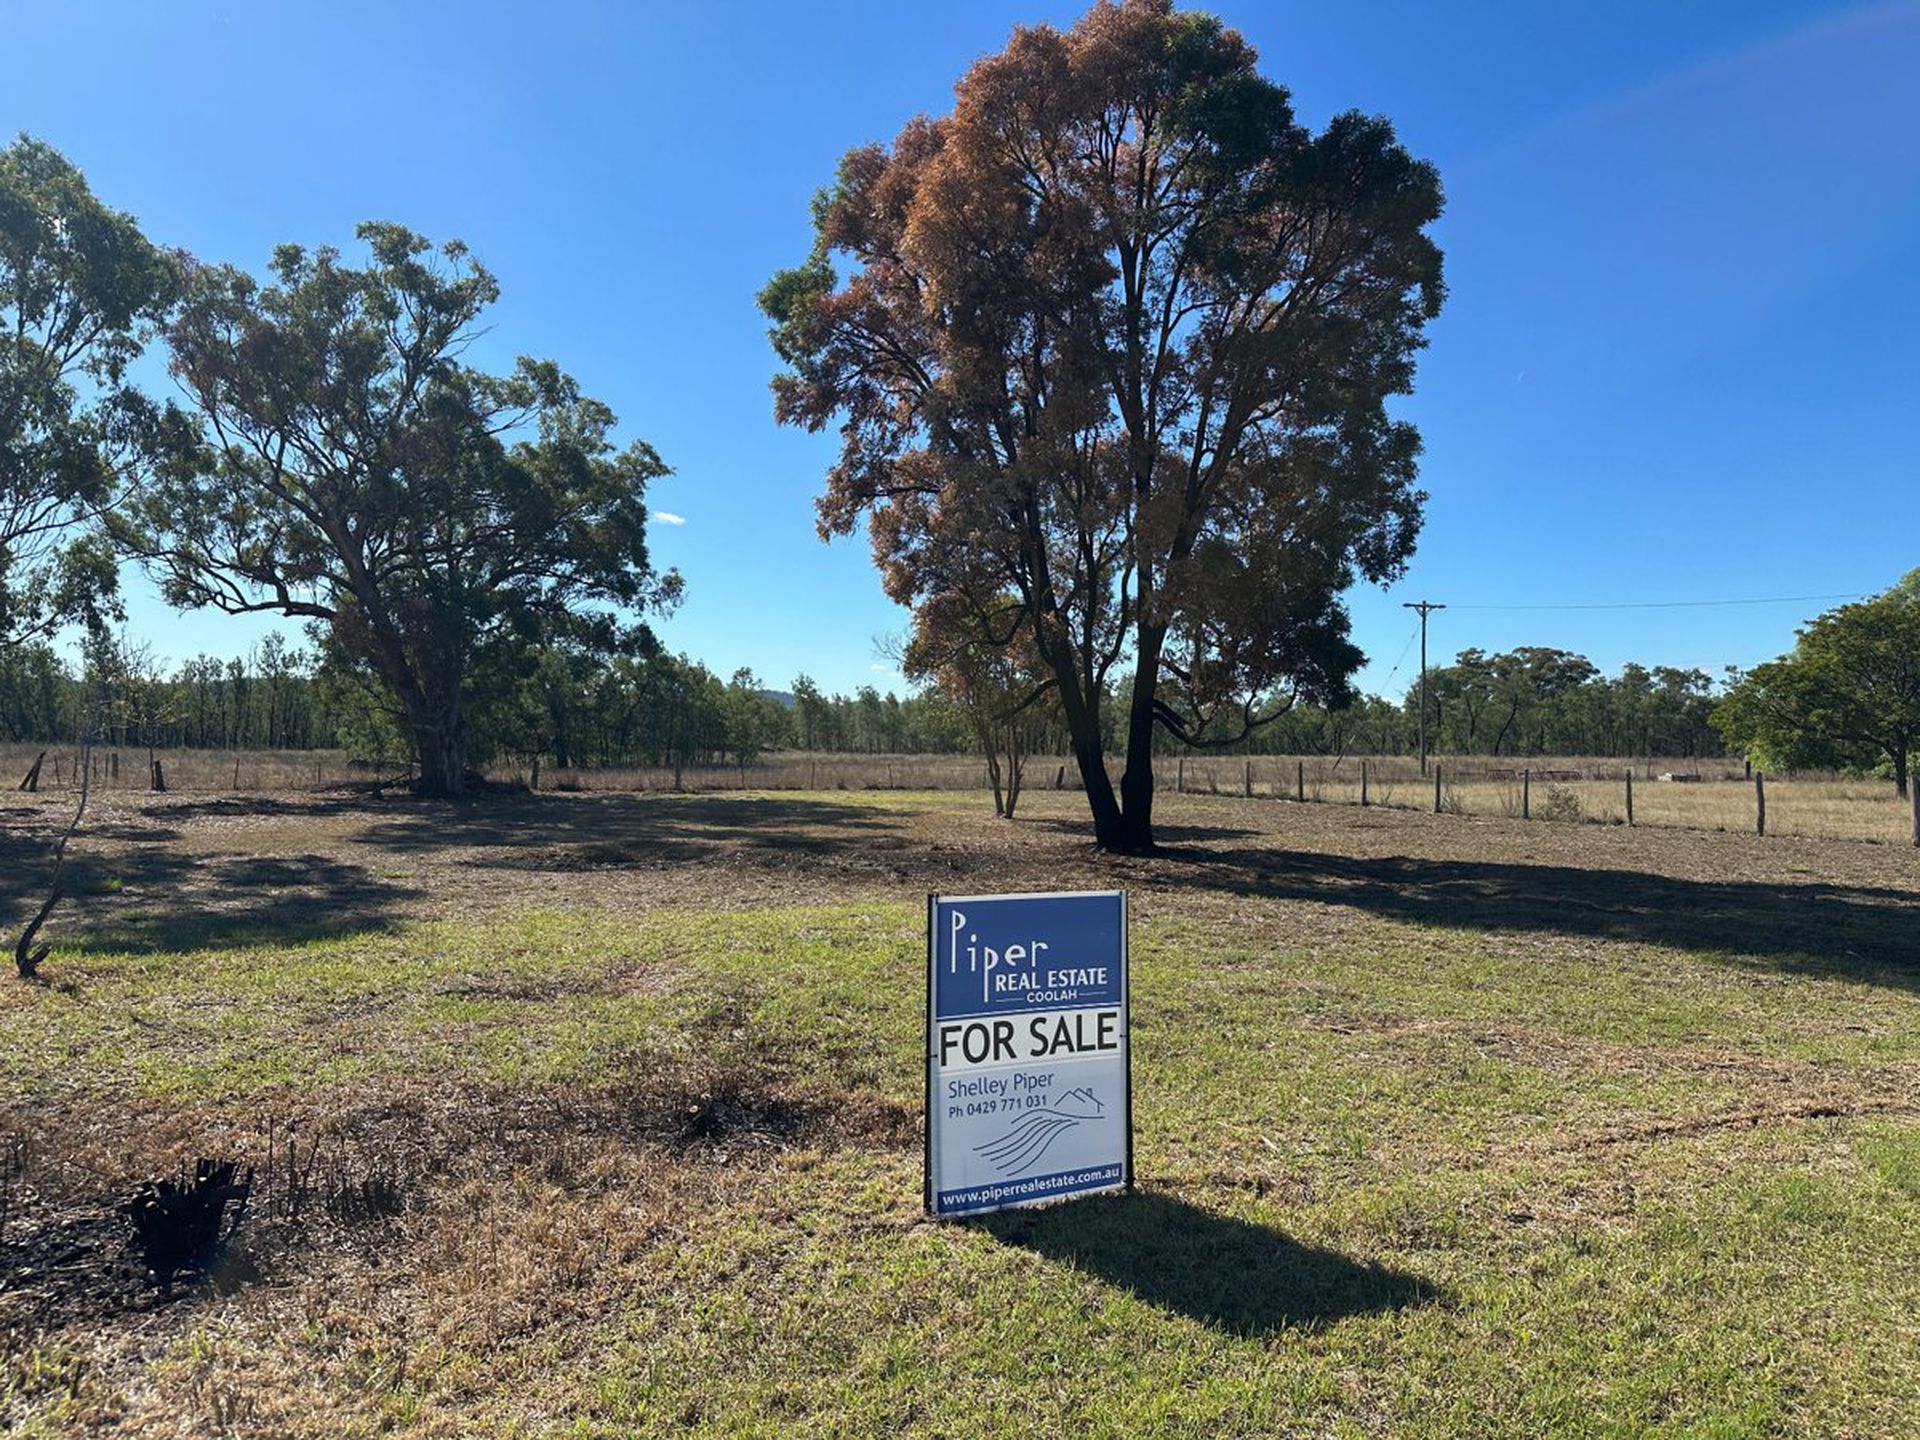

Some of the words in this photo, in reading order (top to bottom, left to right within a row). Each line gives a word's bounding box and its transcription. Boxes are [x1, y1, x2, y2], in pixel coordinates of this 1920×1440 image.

[951, 910, 1049, 1003] Piper
[995, 972, 1041, 992] REAL
[1048, 967, 1108, 988] ESTATE
[1026, 990, 1078, 1003] COOLAH
[940, 1020, 1017, 1067] FOR
[1029, 1012, 1118, 1057] SALE
[948, 1077, 1009, 1098] Shelley
[1013, 1073, 1055, 1093] Piper
[949, 1107, 963, 1118] Ph
[966, 1101, 997, 1115] 0429
[1001, 1098, 1022, 1112] 771
[1026, 1095, 1047, 1109] 031
[942, 1167, 1120, 1206] www.piperrealestate.com.au
